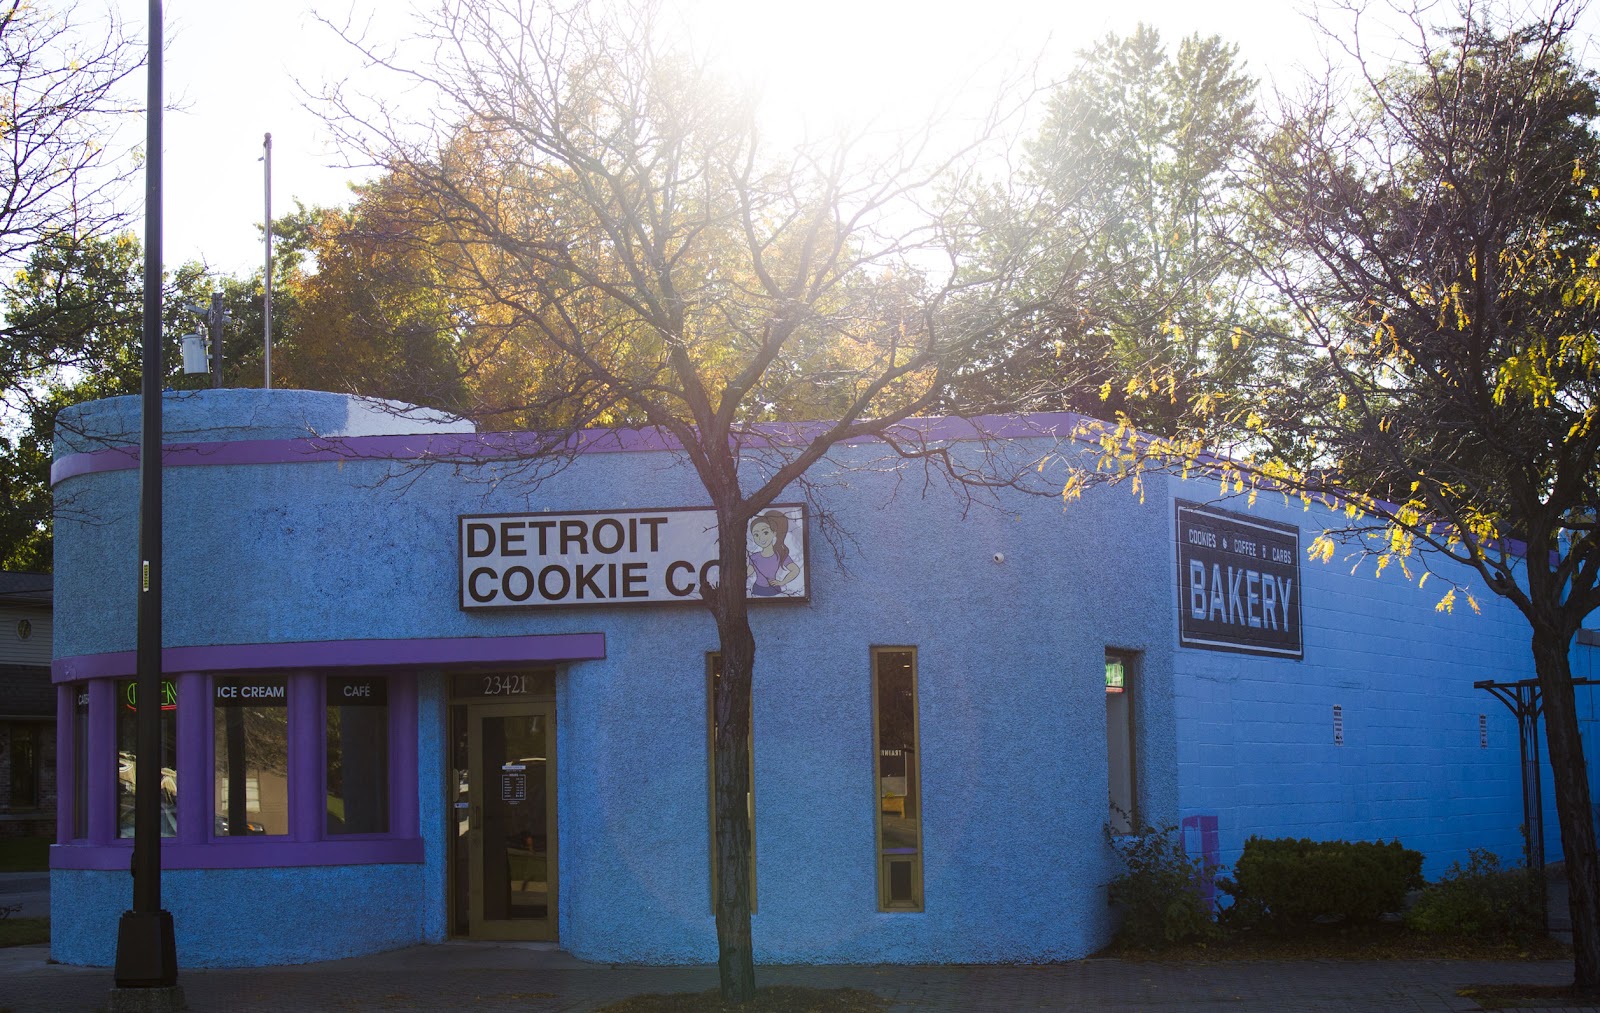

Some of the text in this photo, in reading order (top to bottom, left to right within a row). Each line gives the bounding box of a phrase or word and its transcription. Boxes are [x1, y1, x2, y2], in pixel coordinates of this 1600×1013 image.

[467, 517, 668, 558] DETROIT
[1188, 528, 1292, 564] COOKIES COFFEE CARBS
[468, 562, 649, 602] COOKIE
[1189, 558, 1292, 632] BAKERY
[217, 686, 284, 698] ICE CREAM
[343, 682, 370, 697] CAFÉ
[484, 675, 527, 694] 23421
